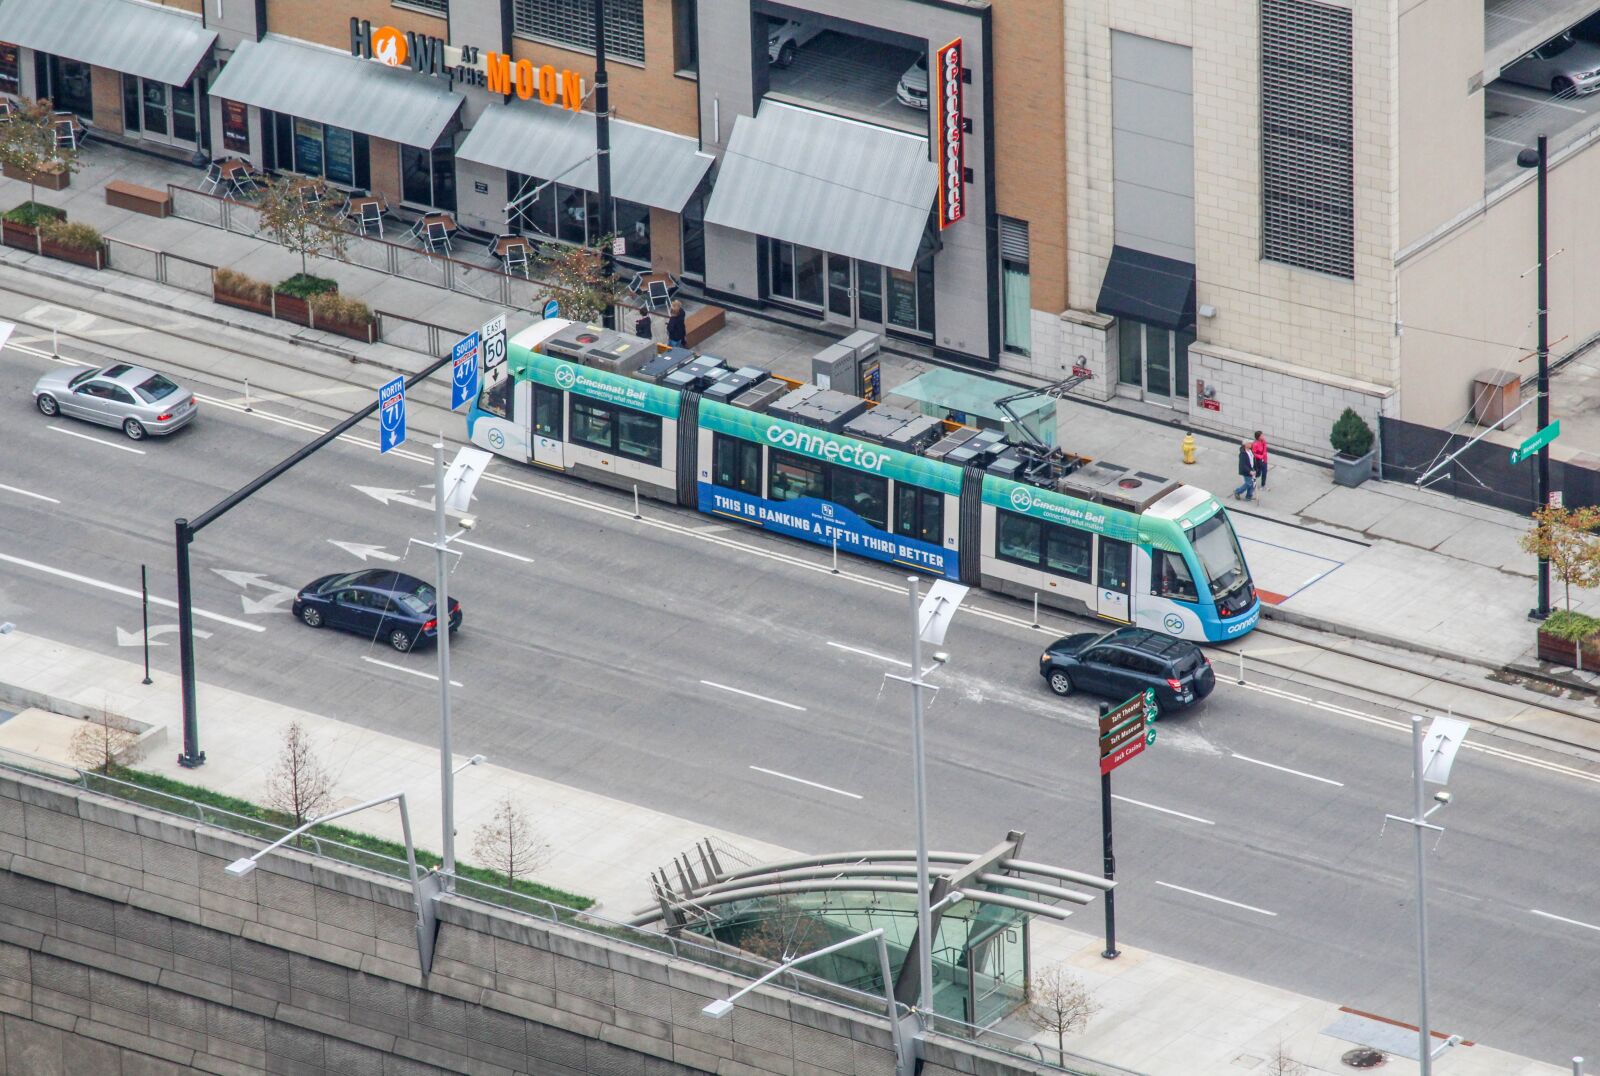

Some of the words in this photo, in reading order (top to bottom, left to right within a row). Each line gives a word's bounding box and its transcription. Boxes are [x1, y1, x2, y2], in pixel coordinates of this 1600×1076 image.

[350, 16, 451, 79] HOWL
[461, 44, 480, 64] AT
[456, 65, 485, 88] THE
[486, 51, 582, 112] MOON
[948, 50, 960, 219] SPLITSVILLE
[486, 320, 502, 336] EAST
[456, 337, 475, 356] SOUTH
[487, 339, 503, 363] 50
[456, 358, 475, 380] 471
[381, 381, 402, 399] NORTH
[576, 375, 625, 395] Cincinnati
[626, 388, 645, 401] Bell
[386, 404, 399, 424] 71
[766, 424, 891, 471] connector
[1032, 497, 1083, 518] Cincinnati
[1085, 511, 1105, 525] Bell
[1043, 510, 1071, 524] connecting
[714, 494, 741, 512] THIS
[744, 503, 756, 516] IS
[759, 507, 810, 532] BANKING
[813, 522, 823, 535] A
[825, 525, 859, 545] FIFTH
[862, 534, 896, 554] THIRD
[899, 545, 944, 568] BETTER
[1111, 713, 1122, 723] Taft
[1122, 701, 1141, 717] Theater
[1110, 735, 1121, 745] Taft
[1121, 723, 1142, 739] Museum
[1125, 742, 1142, 755] Casino
